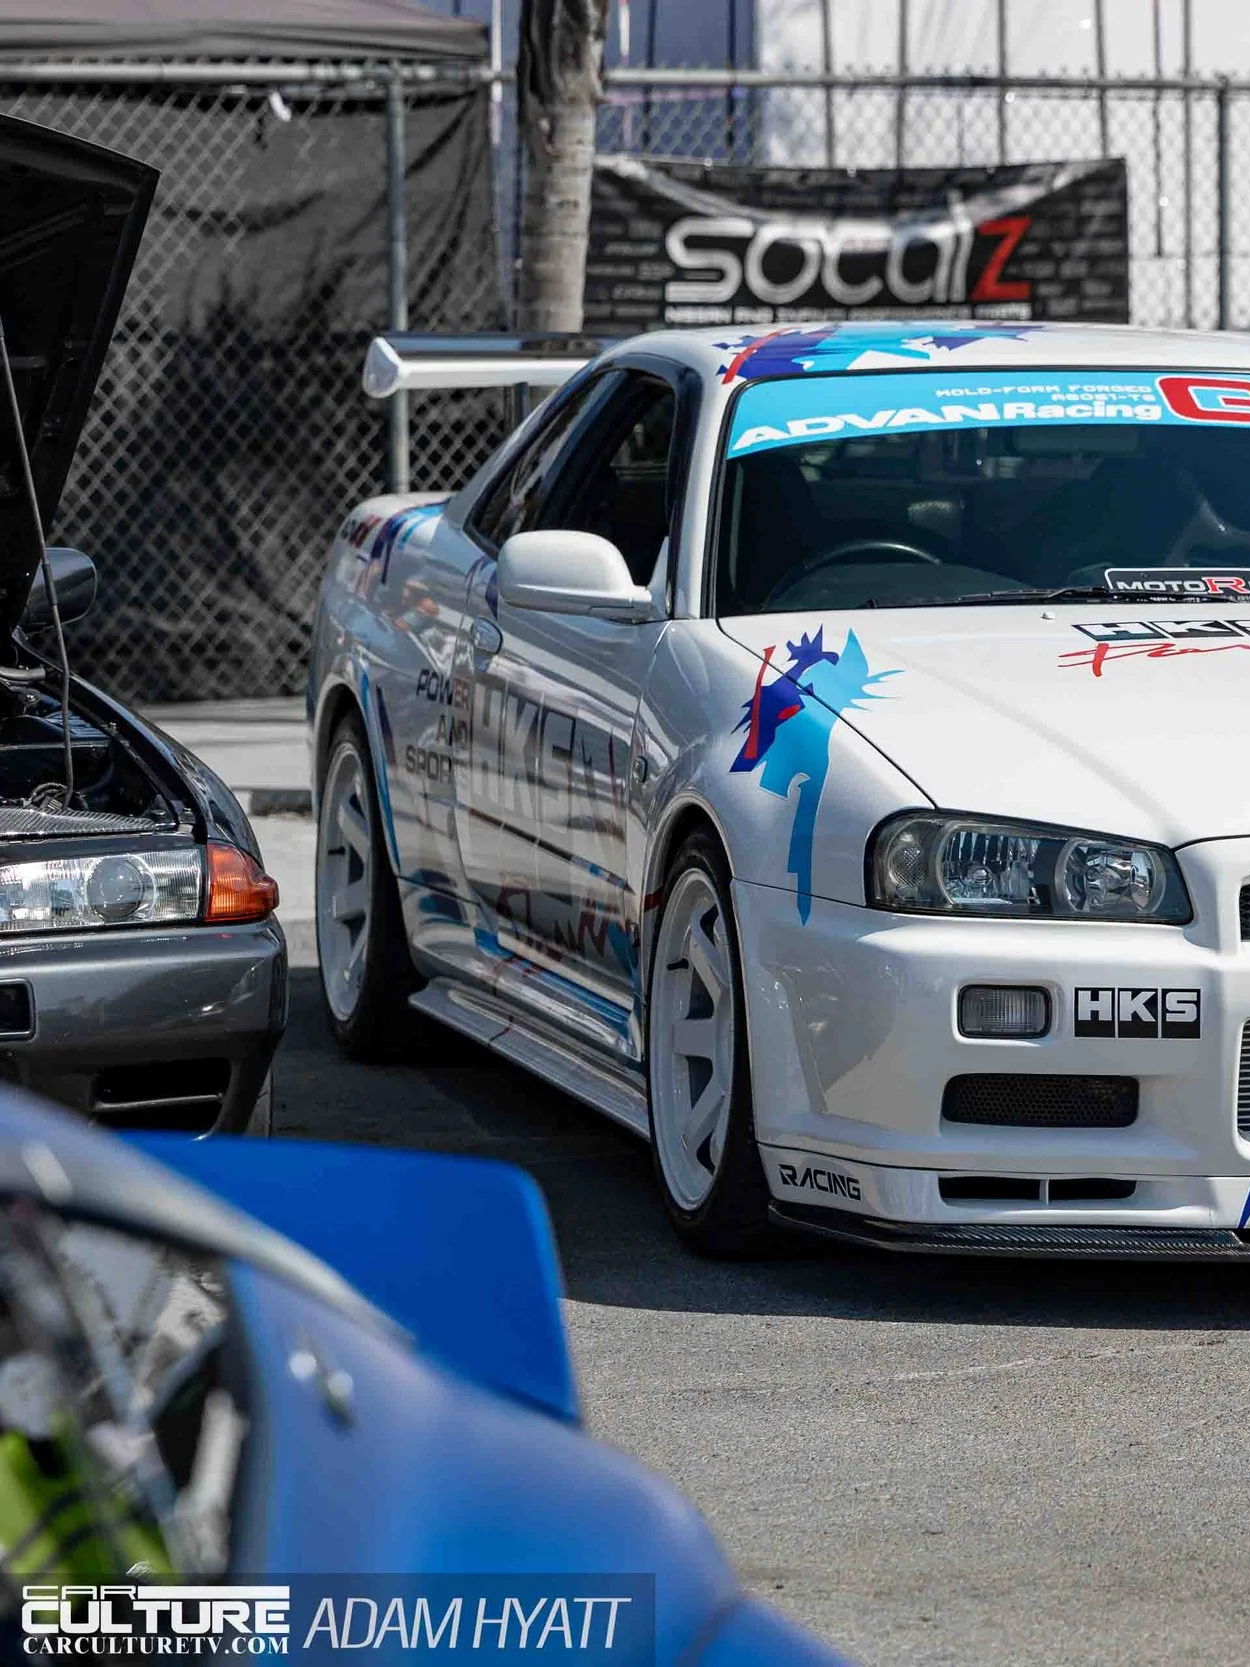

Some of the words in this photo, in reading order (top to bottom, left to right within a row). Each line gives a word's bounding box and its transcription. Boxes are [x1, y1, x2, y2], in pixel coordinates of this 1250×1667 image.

[732, 402, 1001, 450] ADVAN
[1003, 399, 1162, 420] Racing
[416, 668, 469, 711] POWER
[436, 713, 469, 748] AND
[1076, 988, 1199, 1030] HKS
[778, 1163, 862, 1201] RACING
